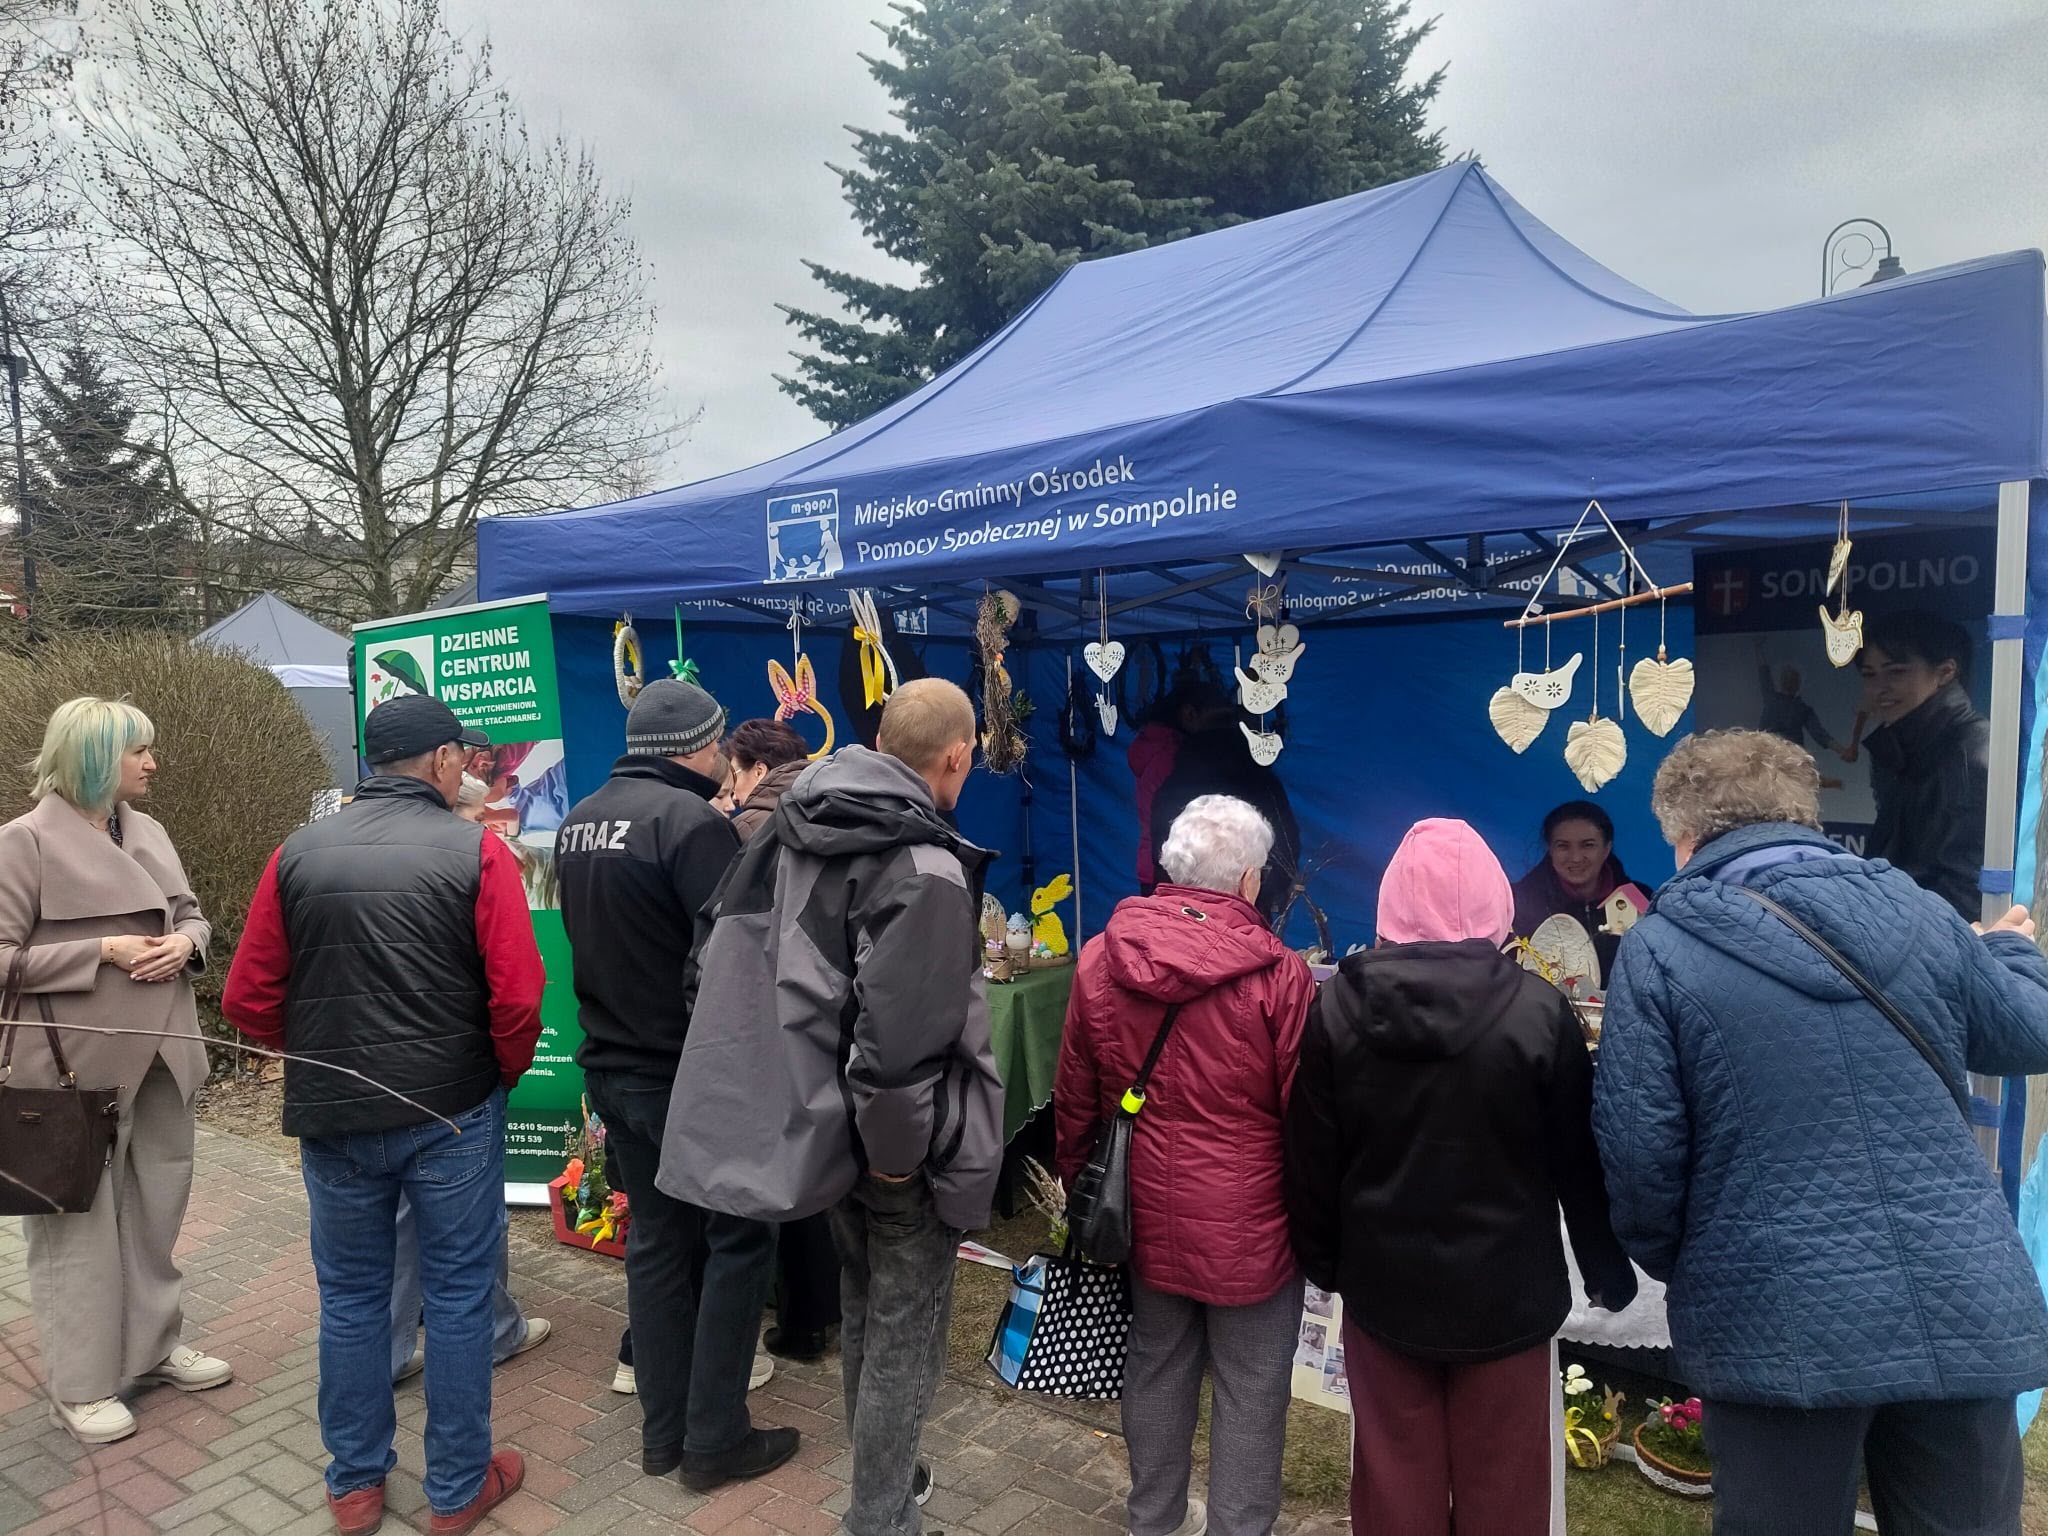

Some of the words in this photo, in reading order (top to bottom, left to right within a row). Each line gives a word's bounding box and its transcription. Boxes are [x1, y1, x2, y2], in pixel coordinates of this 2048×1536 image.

[854, 481, 1023, 528] Miejsko-Gminny
[1028, 455, 1135, 497] Ośrodek
[856, 535, 939, 562] Pomocy
[942, 509, 1062, 551] Społecznej
[1068, 512, 1090, 531] w
[1092, 482, 1238, 527] Sompolnie
[440, 625, 519, 653] DZIENNE
[440, 650, 530, 677] CENTRUM
[440, 675, 537, 702] WSPARCIA
[451, 706, 474, 716] IEKA
[474, 700, 537, 714] WYTCHNIENIOWA
[484, 712, 542, 725] STACJONARNEJ
[532, 1054, 573, 1063] rzestrzeń
[507, 1122, 536, 1131] 62-610
[536, 1123, 578, 1134] Sompolo
[510, 1134, 526, 1143] 175
[527, 1135, 543, 1143] 539
